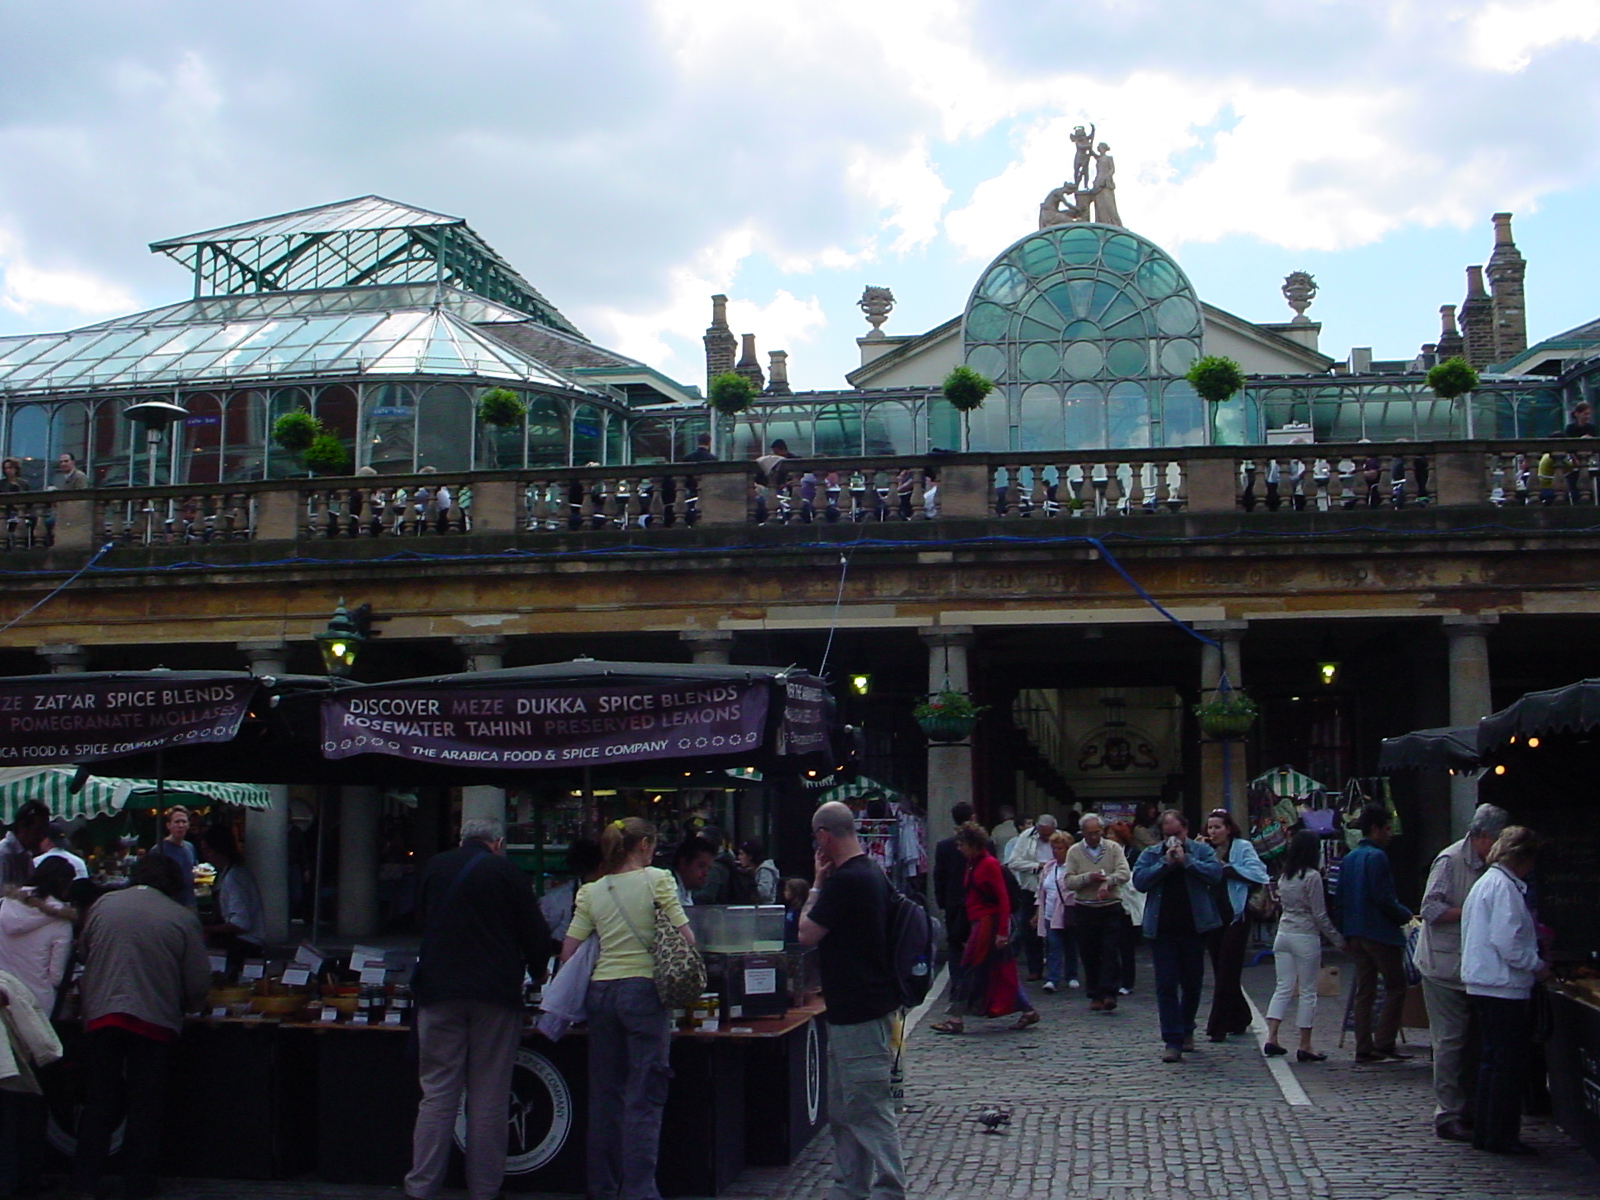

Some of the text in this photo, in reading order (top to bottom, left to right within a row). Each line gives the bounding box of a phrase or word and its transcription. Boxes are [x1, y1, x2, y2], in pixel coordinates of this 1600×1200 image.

[0, 696, 22, 711] ZE
[107, 690, 156, 708] SPICE
[162, 685, 235, 705] BLENDS
[349, 685, 738, 716] DISCOVER MEZE DUKKA SPICE BLENDS
[10, 713, 144, 732] POMEGRANATE
[343, 704, 742, 737] ROSEWATER TAHINI PRESERVED LEMONS
[22, 745, 57, 758] FOOD
[59, 744, 70, 756] &
[75, 743, 109, 756] SPICE
[113, 736, 169, 753] COMPANY
[410, 739, 669, 762] THE ARABICA FOOD & SPICE COMPANY
[544, 1072, 566, 1119] COMPANY
